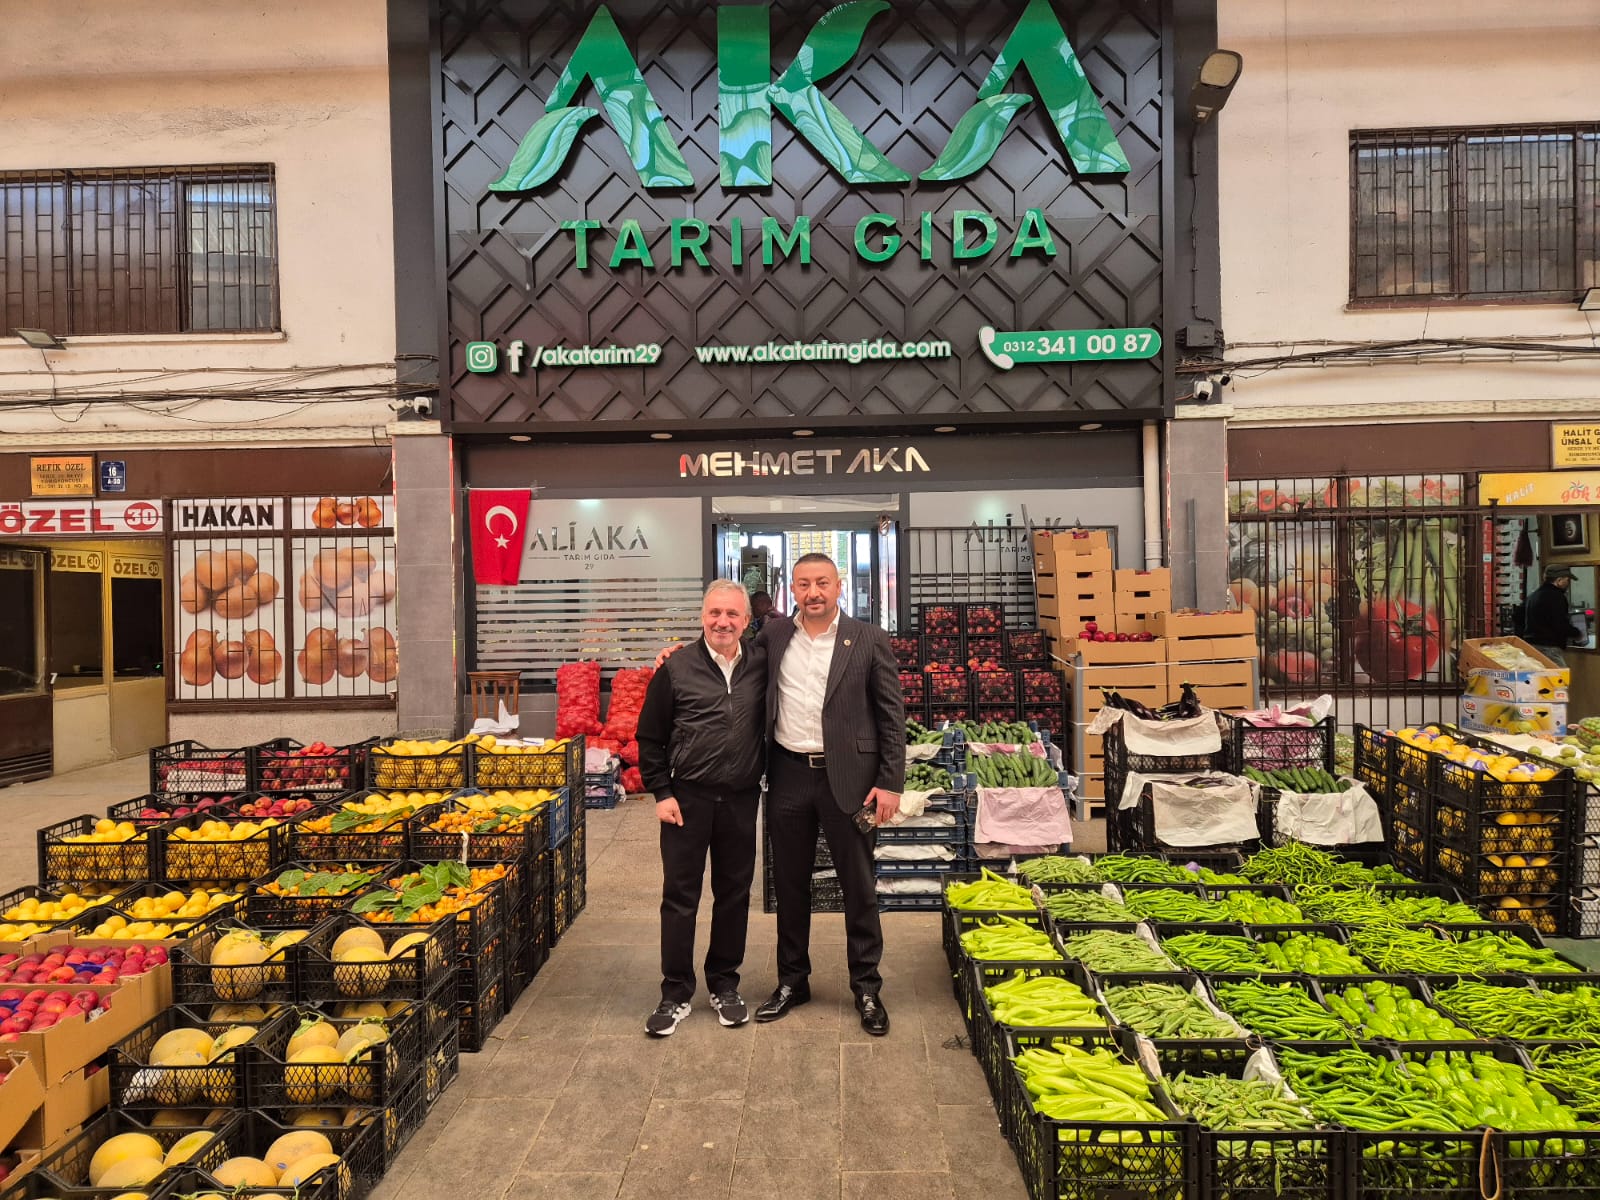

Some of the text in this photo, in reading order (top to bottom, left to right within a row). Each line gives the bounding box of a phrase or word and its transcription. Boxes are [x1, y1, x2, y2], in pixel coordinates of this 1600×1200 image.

[488, 0, 1131, 190] AKA
[560, 207, 1058, 268] TARIM GIDA
[531, 343, 662, 368] /akatarim29
[695, 339, 951, 364] www.akatarimgida.com
[1003, 333, 1153, 355] 0312 341 00 87
[65, 461, 86, 471] ÖZEL
[680, 446, 931, 478] MEHMET AKA
[0, 504, 157, 533] ÖZEL 30
[183, 504, 274, 528] HAKAN
[530, 521, 649, 551] ALİ AKA
[88, 555, 99, 568] 30
[113, 559, 159, 575] ÖZEL 30
[594, 553, 615, 561] GIDA
[1021, 555, 1031, 563] 29
